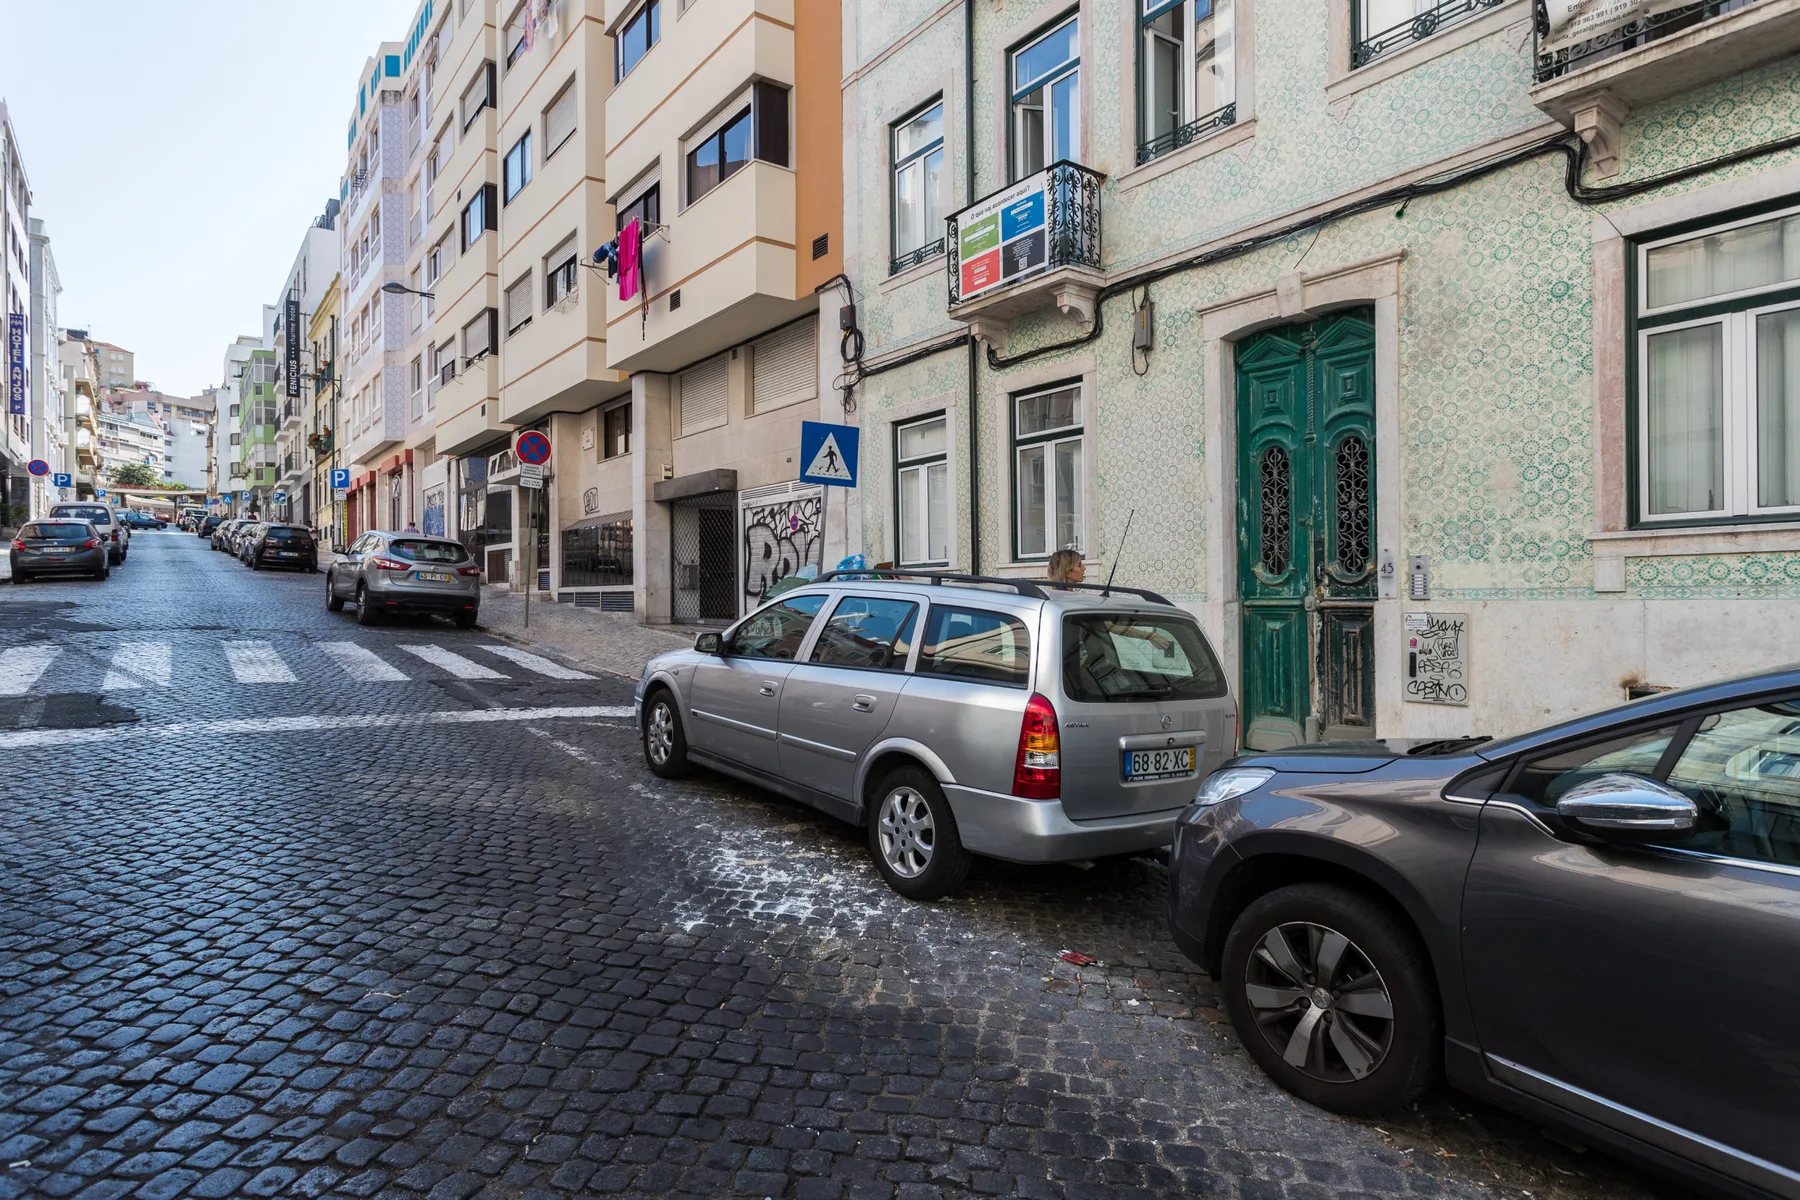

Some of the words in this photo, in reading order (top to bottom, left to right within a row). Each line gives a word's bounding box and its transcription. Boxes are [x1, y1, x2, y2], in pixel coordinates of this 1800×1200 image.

[1582, 14, 1595, 24] 963
[1596, 9, 1609, 19] 991
[1614, 2, 1628, 12] 919
[975, 207, 984, 219] que
[984, 204, 992, 213] vai
[992, 192, 1016, 210] acontecer
[1016, 184, 1031, 197] aqui?
[12, 328, 22, 364] HOTEL
[12, 366, 23, 401] ANJOS
[289, 360, 298, 395] FENICIUS
[59, 474, 68, 483] P
[334, 470, 346, 486] P
[1380, 562, 1394, 574] 45
